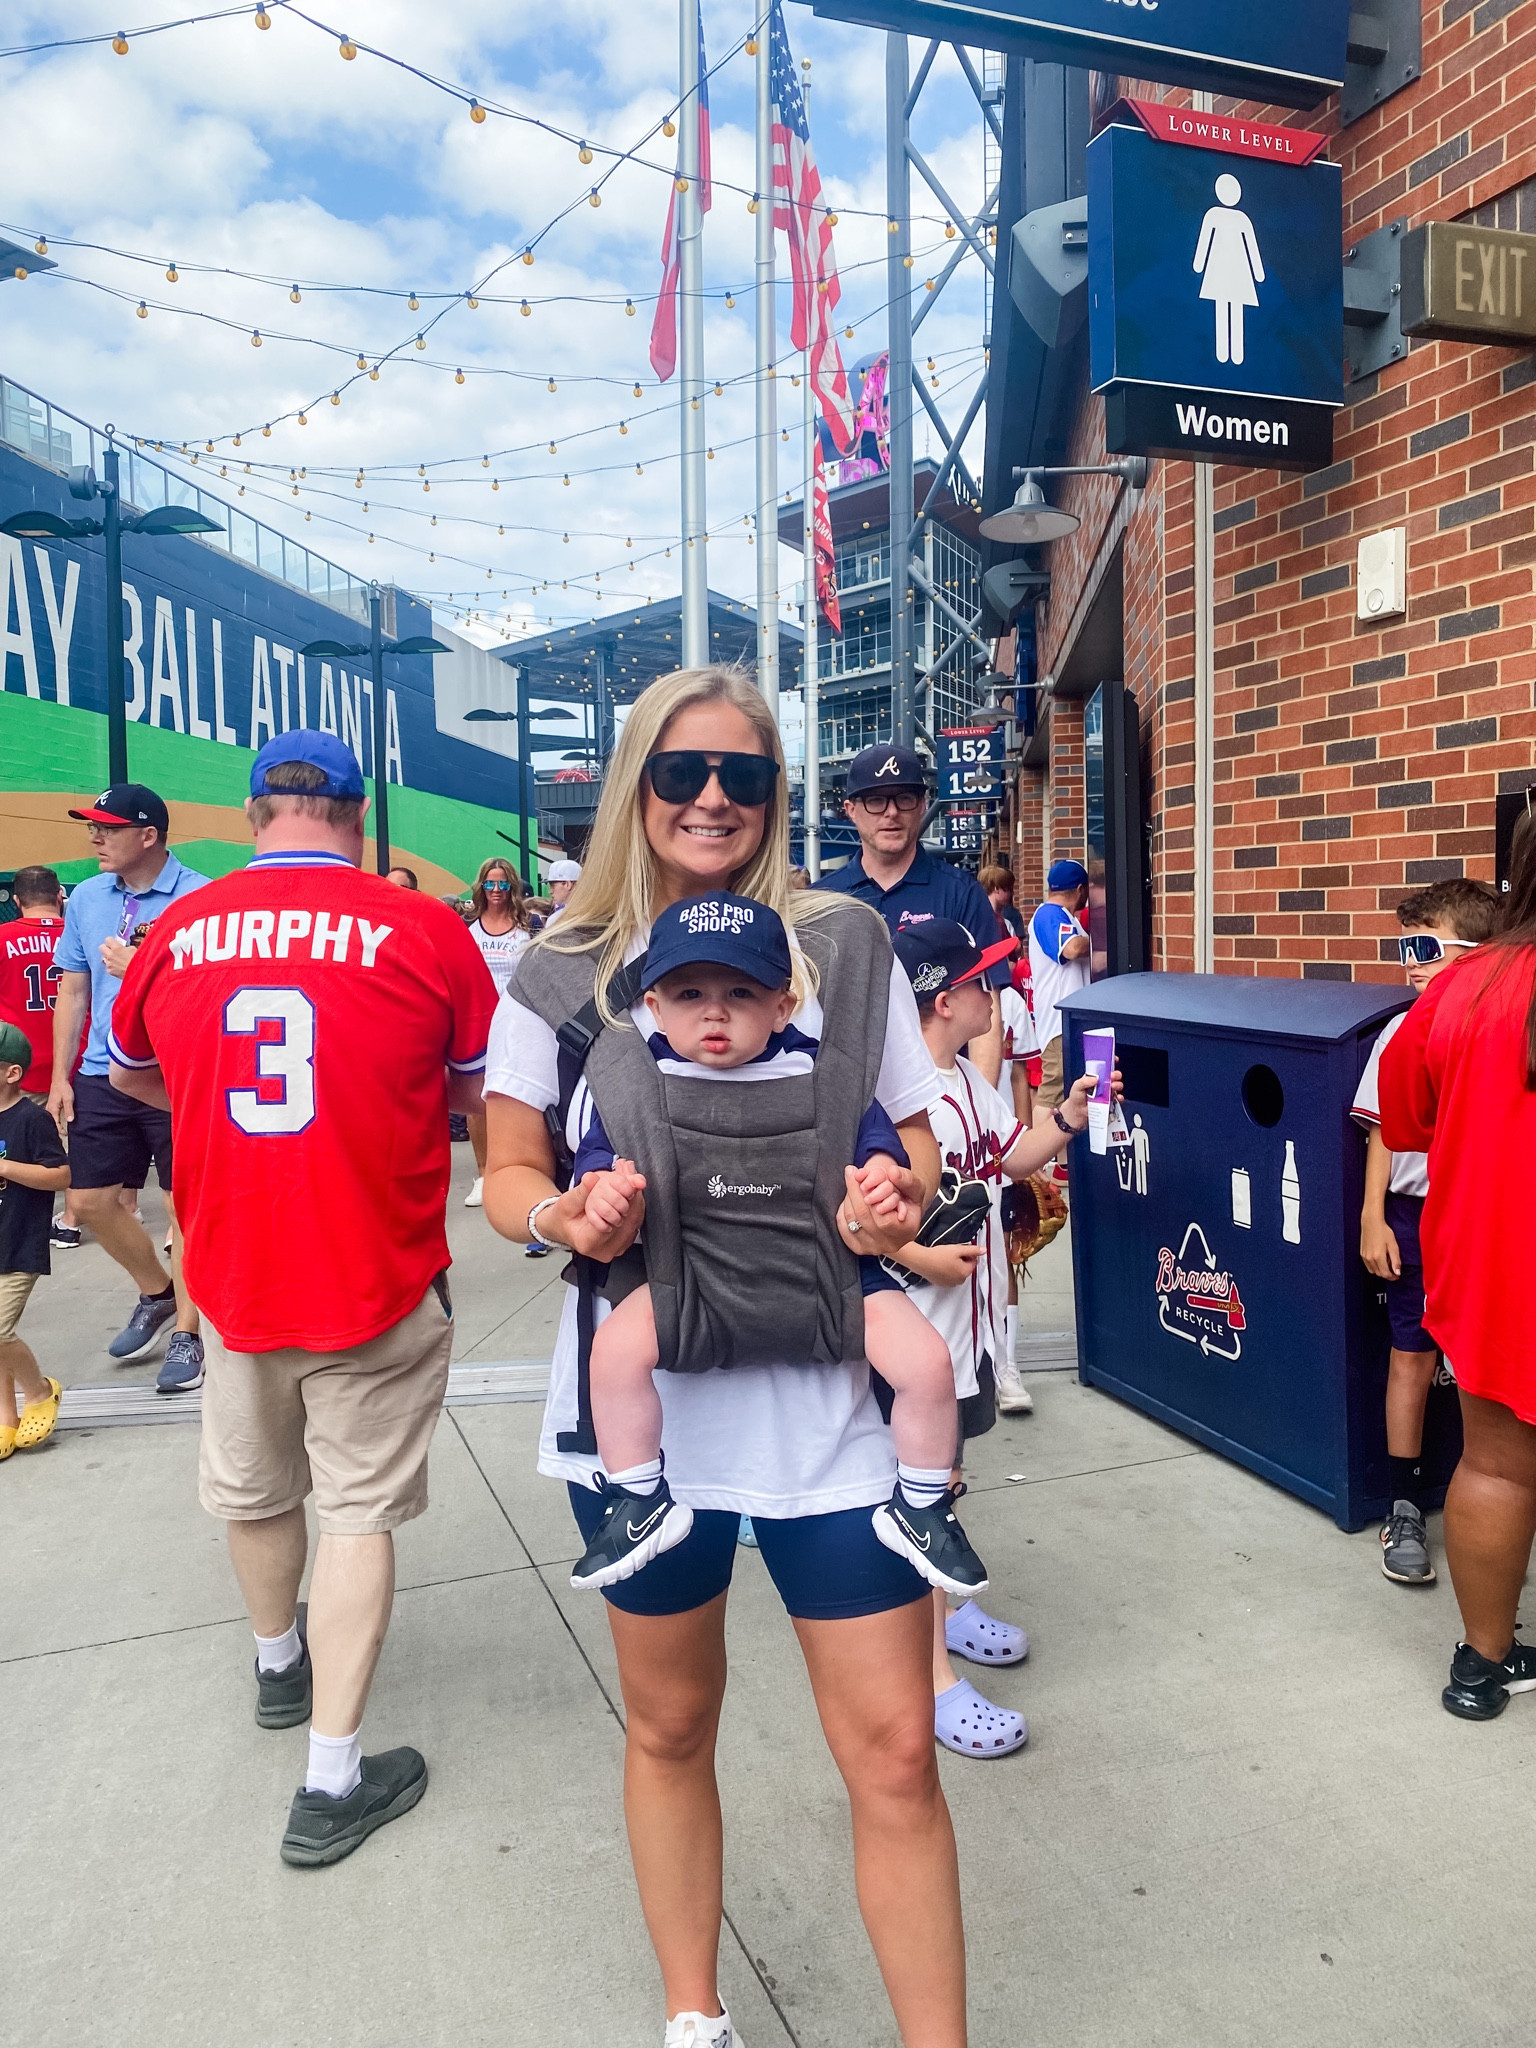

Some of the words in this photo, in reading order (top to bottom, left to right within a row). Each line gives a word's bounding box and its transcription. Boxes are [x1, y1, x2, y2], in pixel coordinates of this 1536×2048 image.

[1168, 115, 1231, 143] LOWER
[1239, 129, 1294, 154] LEVEL
[1455, 240, 1528, 318] EXIT
[1175, 403, 1290, 446] Women
[122, 581, 237, 746] BALL
[948, 739, 992, 763] 152
[679, 900, 720, 923] BASS
[723, 902, 754, 924] PRO
[168, 909, 395, 971] MURPHY
[478, 940, 518, 953] RAVES
[221, 985, 317, 1137] 3
[1175, 1306, 1225, 1337] RECYCLE
